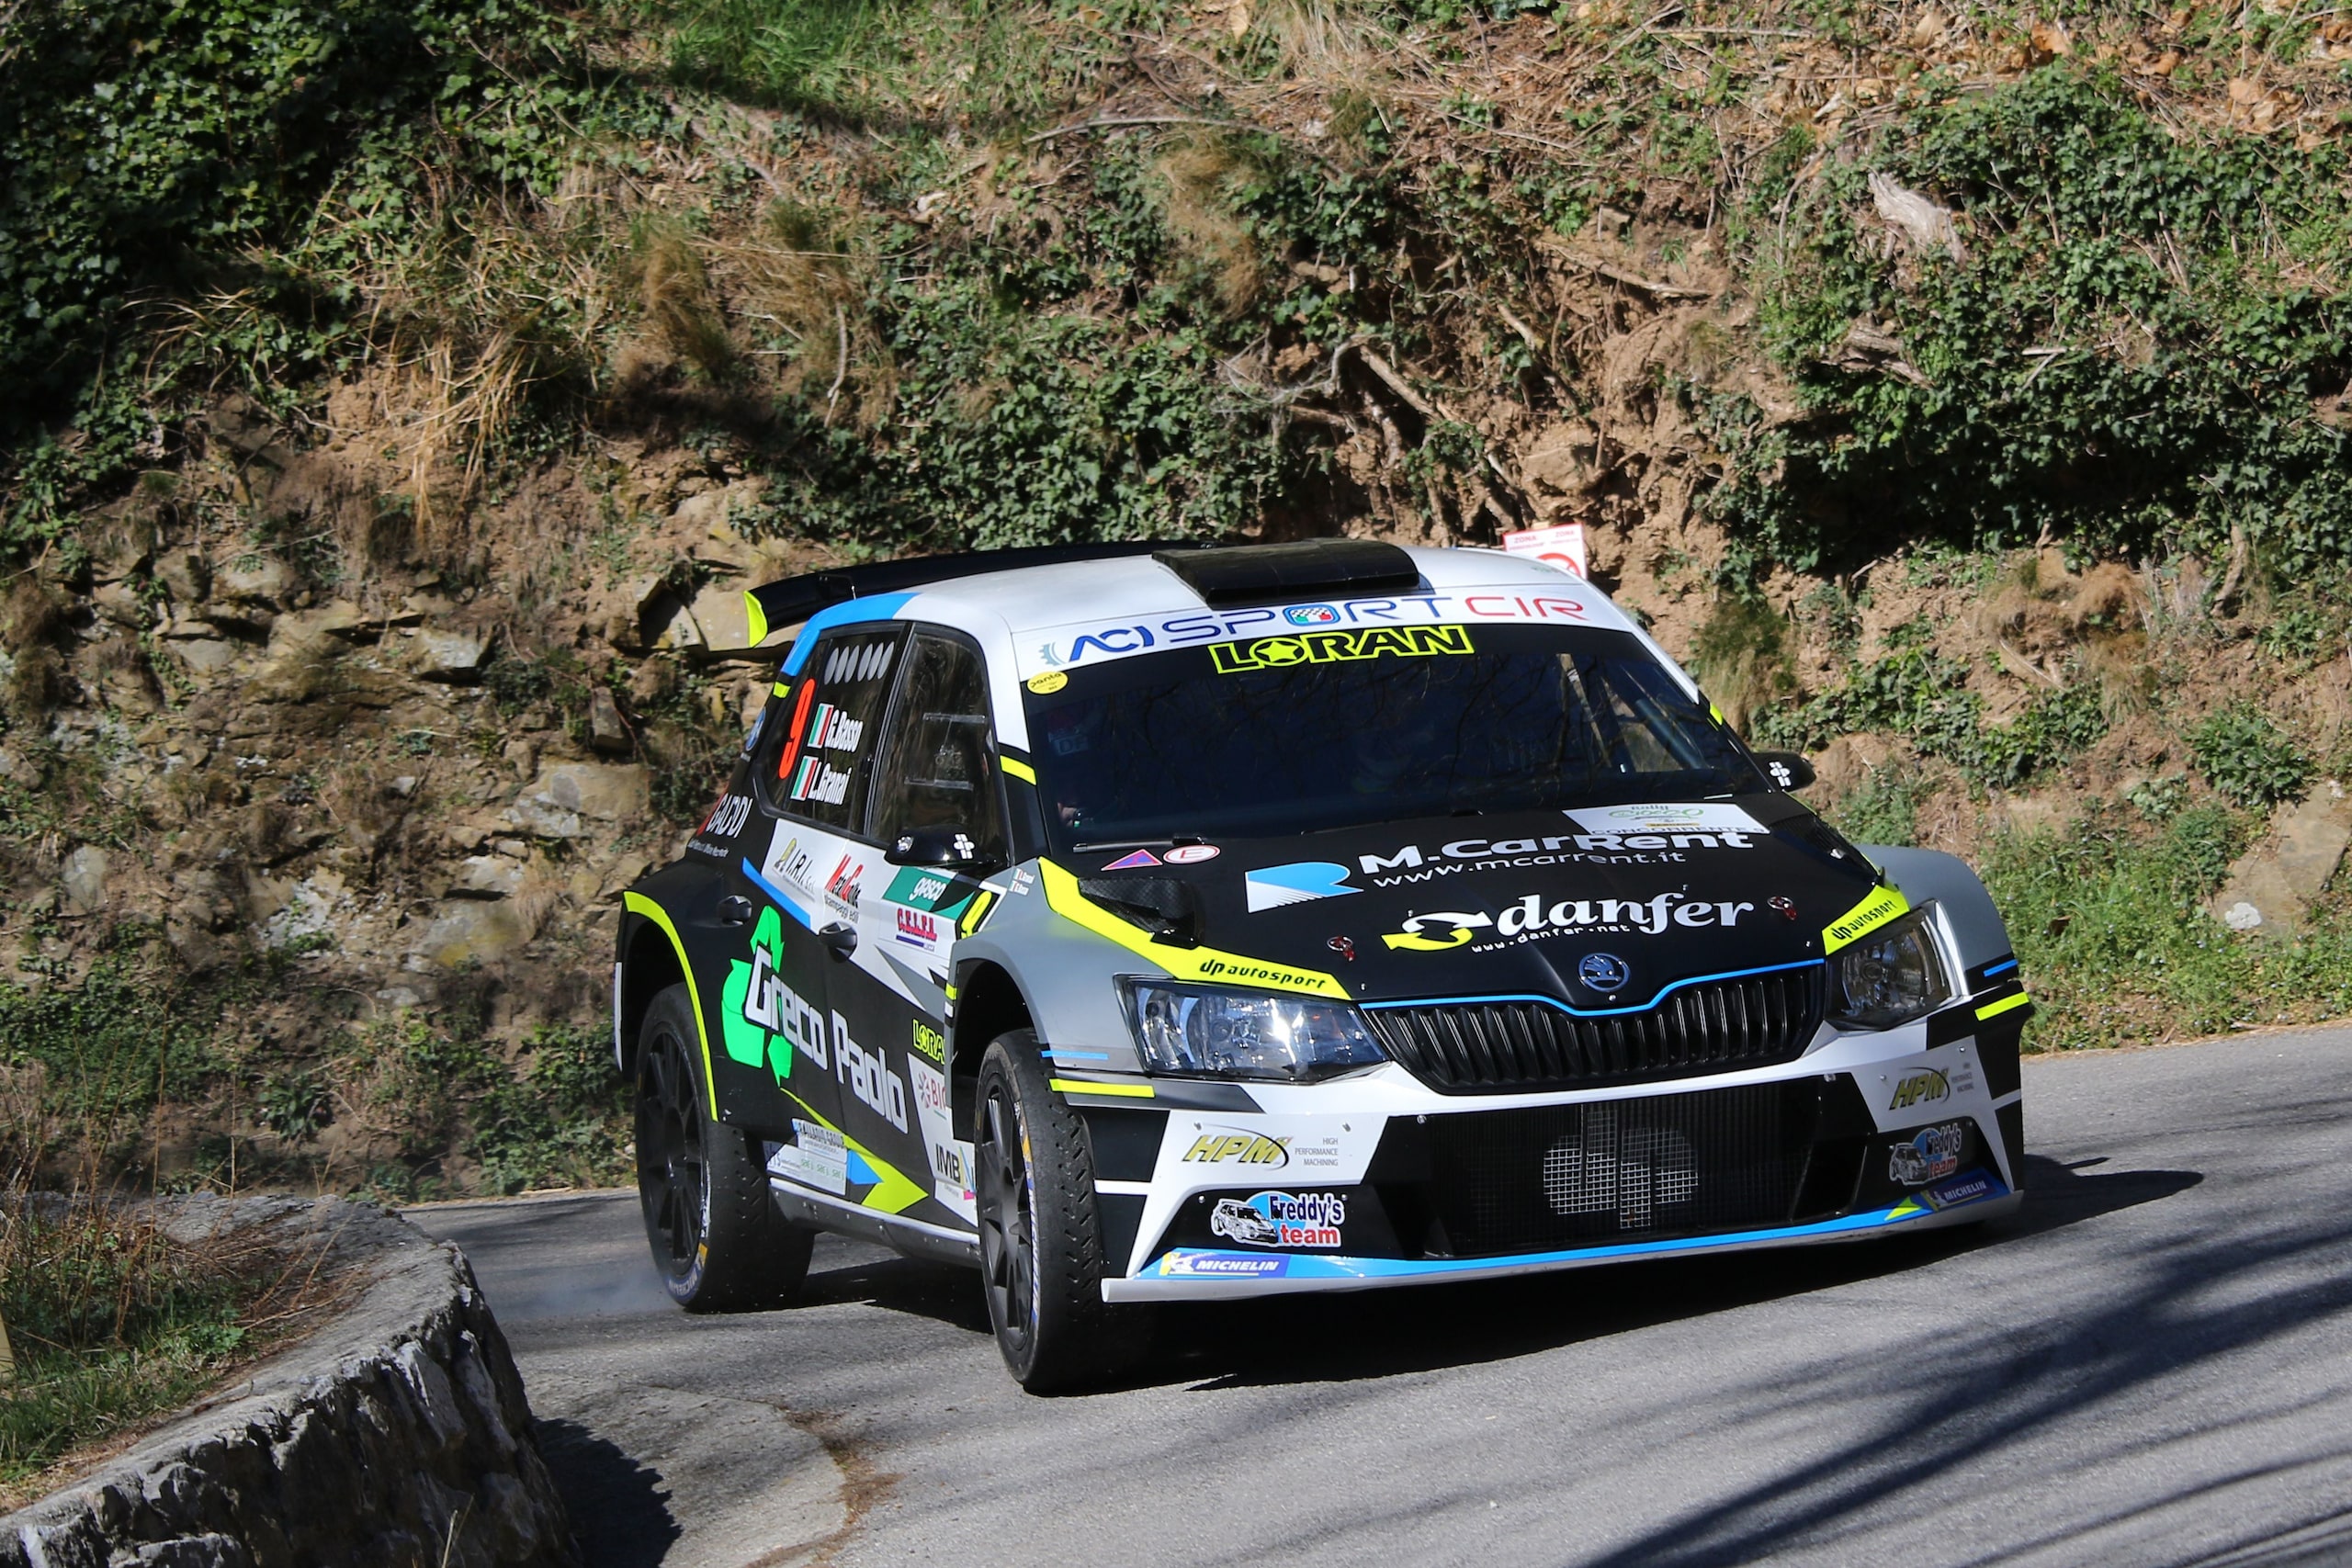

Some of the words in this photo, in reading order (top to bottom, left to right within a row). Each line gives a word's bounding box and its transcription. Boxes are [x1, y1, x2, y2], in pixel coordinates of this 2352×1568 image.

[1464, 596, 1591, 622] CIR
[1208, 625, 1475, 674] LORAN
[778, 678, 816, 779] 9
[1373, 851, 1687, 888] www.mcarrent.it
[1497, 892, 1755, 937] danfer
[1848, 898, 1898, 931] autosport
[1471, 923, 1632, 953] www.danfer.net
[1227, 964, 1327, 989] autosport
[744, 944, 828, 1071] Greco
[831, 1009, 909, 1134] Paolo
[1888, 1067, 1950, 1111] HPM
[1182, 1134, 1294, 1164] HPM
[1295, 1147, 1339, 1156] PERFORMANCE
[1322, 1137, 1339, 1145] HIGH
[1303, 1158, 1339, 1167] MACHINING
[1943, 1180, 1987, 1201] MICHELIN
[1269, 1194, 1342, 1227] Freddy's
[1280, 1224, 1339, 1245] team
[1195, 1260, 1280, 1272] MICHELIN
